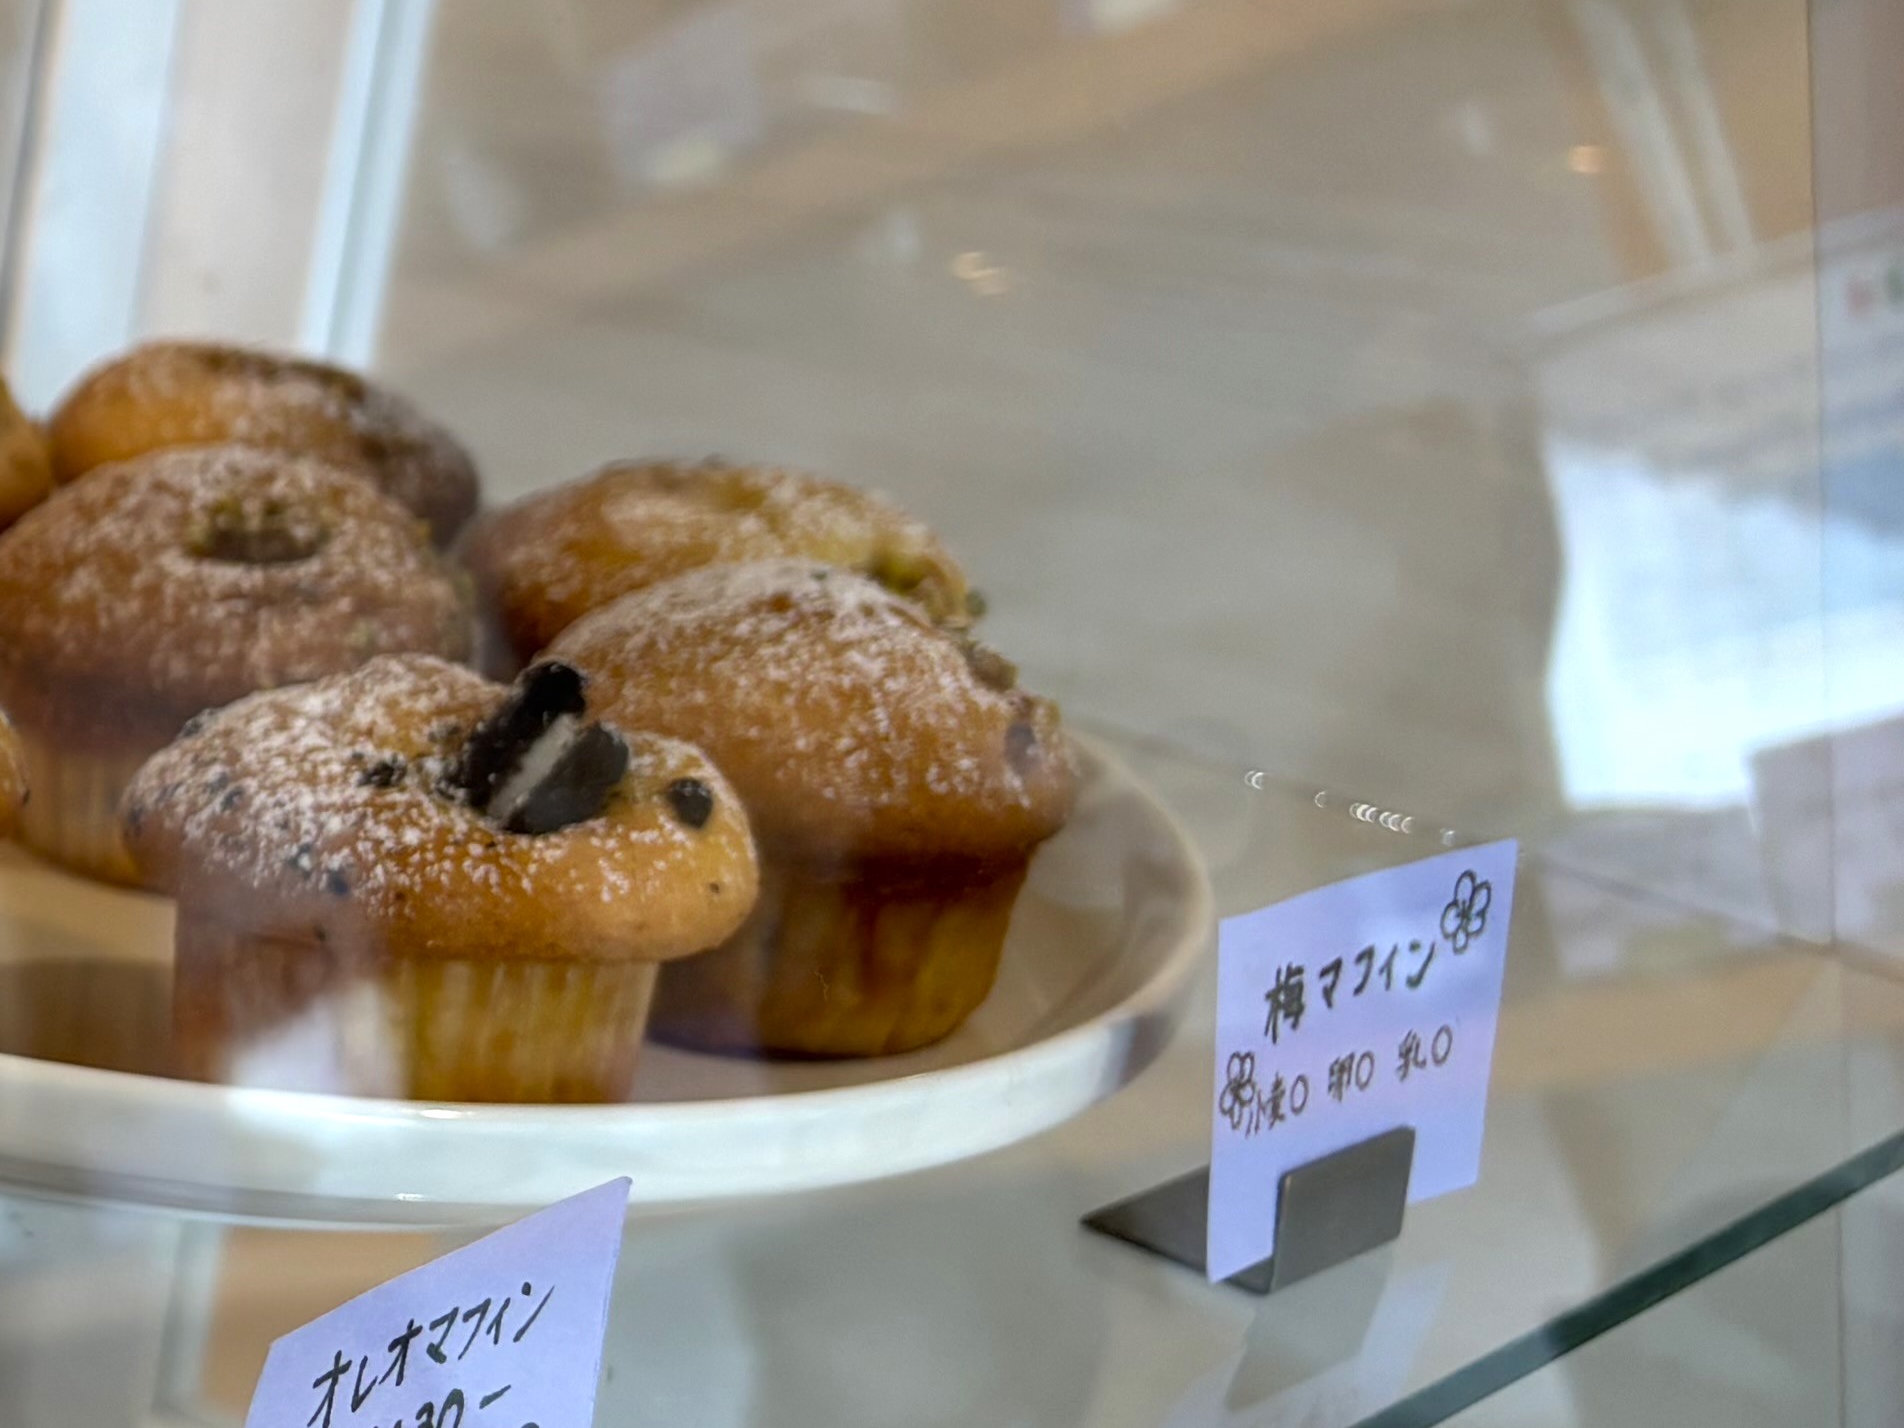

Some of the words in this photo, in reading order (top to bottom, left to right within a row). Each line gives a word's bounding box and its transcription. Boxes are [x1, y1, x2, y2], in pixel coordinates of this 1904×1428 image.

[1264, 941, 1436, 1044] 梅マフィン
